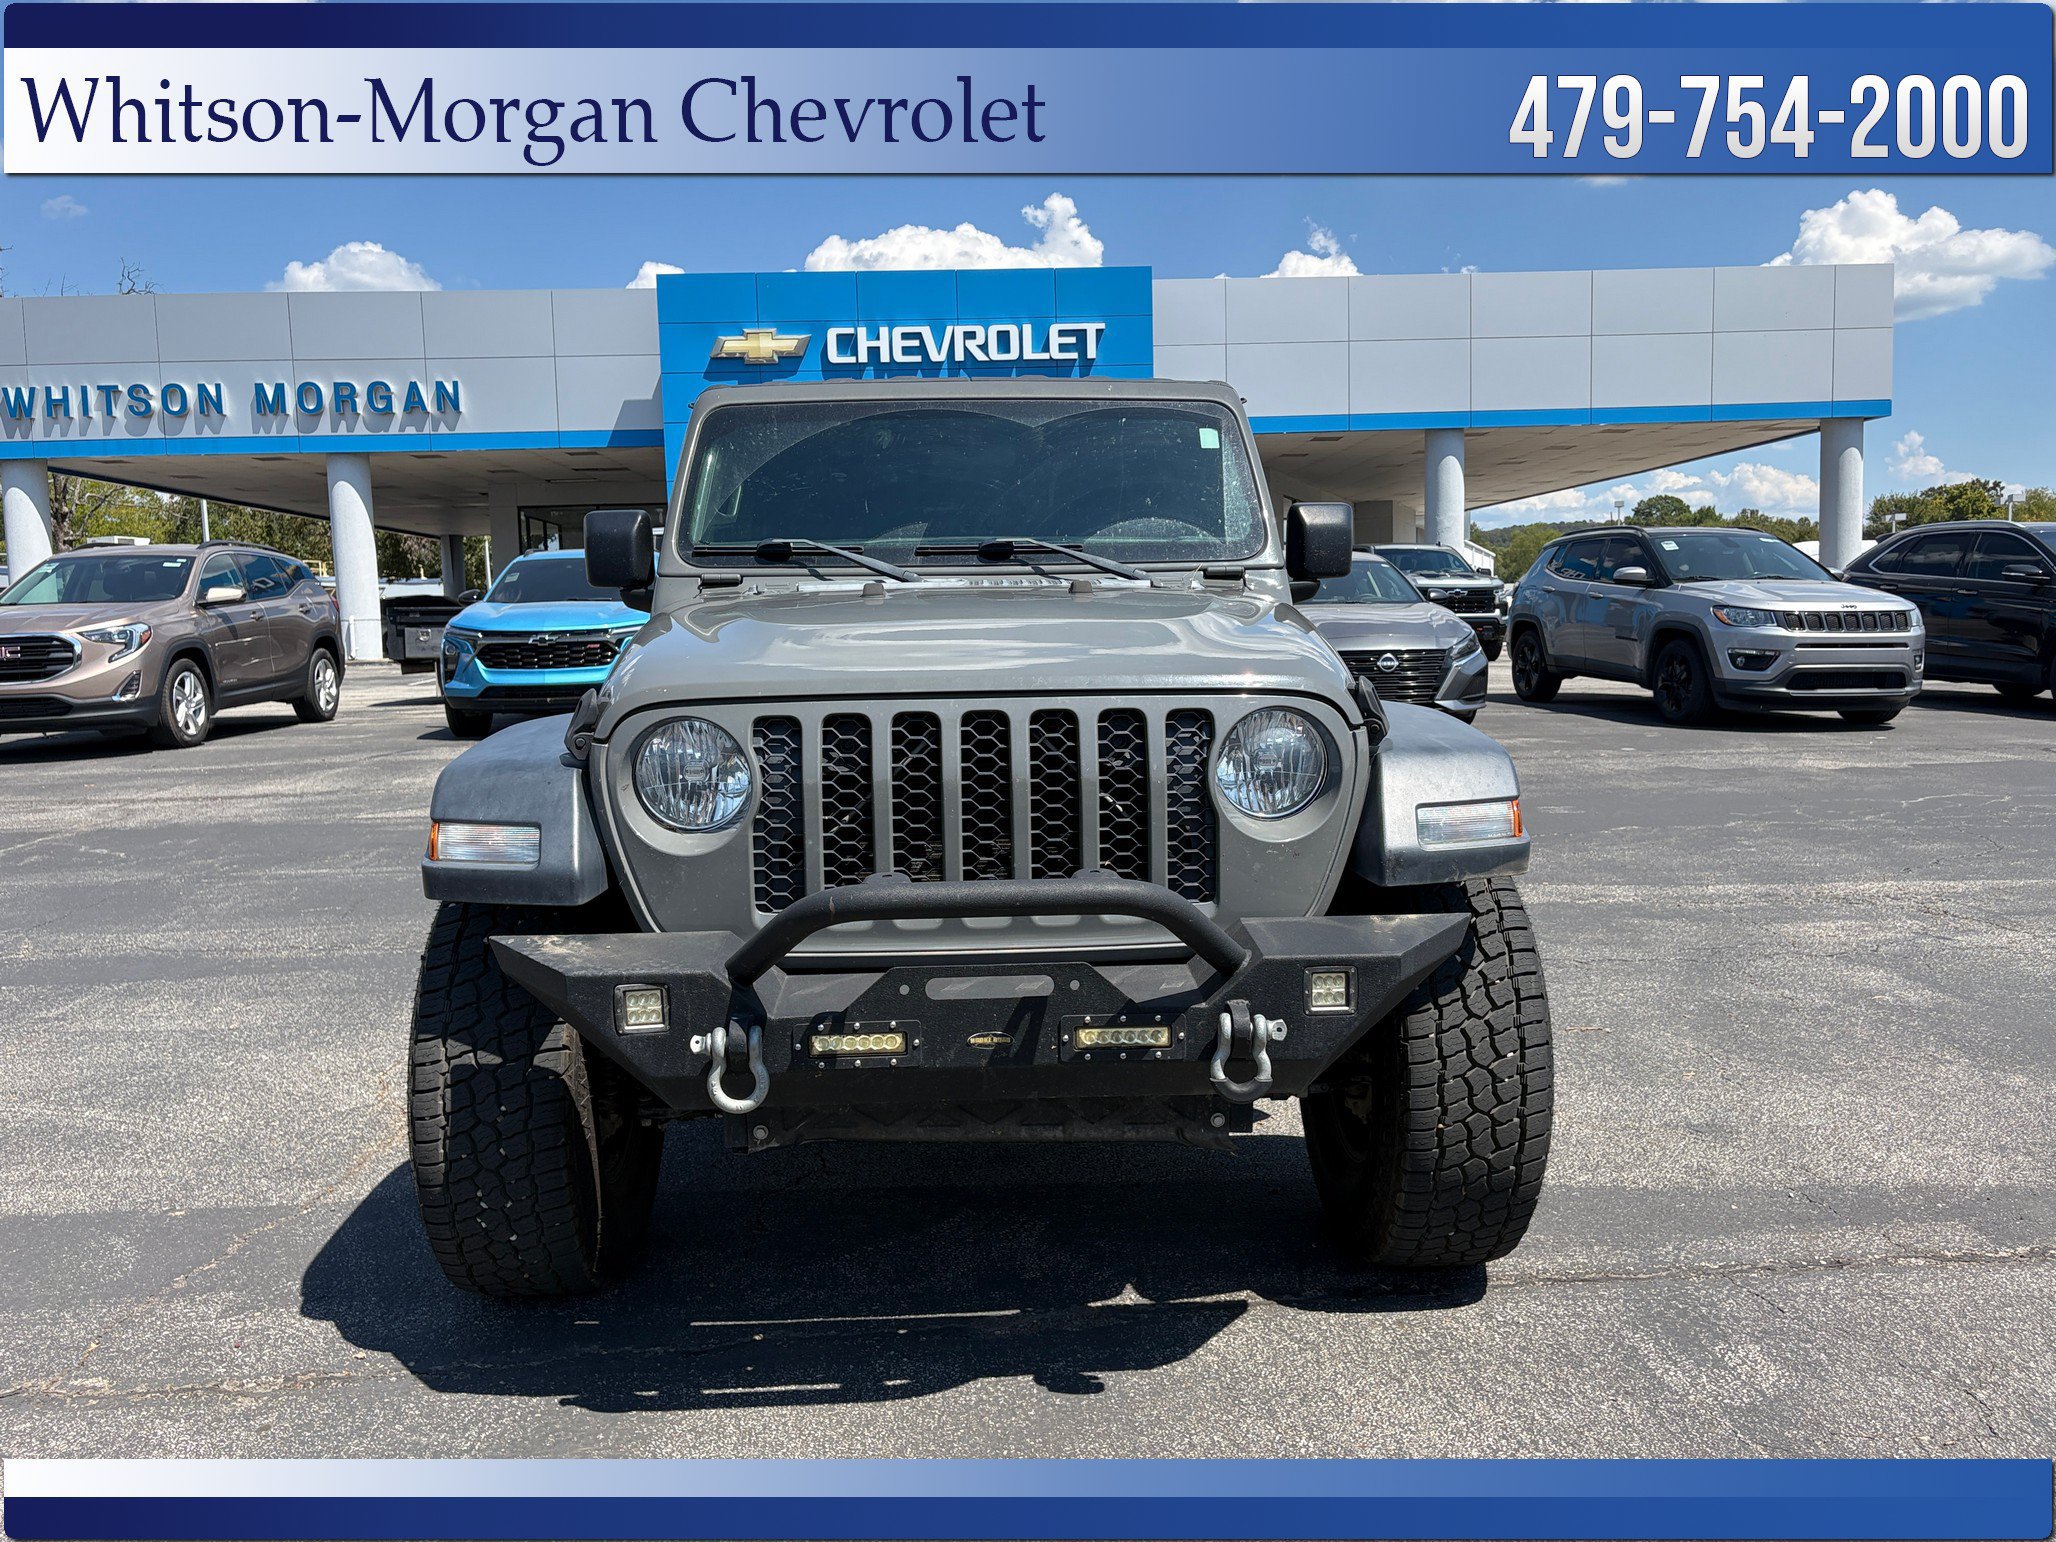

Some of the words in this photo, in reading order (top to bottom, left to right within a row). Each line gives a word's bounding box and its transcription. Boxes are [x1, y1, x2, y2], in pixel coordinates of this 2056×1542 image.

[826, 322, 1106, 364] CHEVROLET
[1, 383, 225, 418] WHITSON
[253, 380, 462, 415] MORGAN
